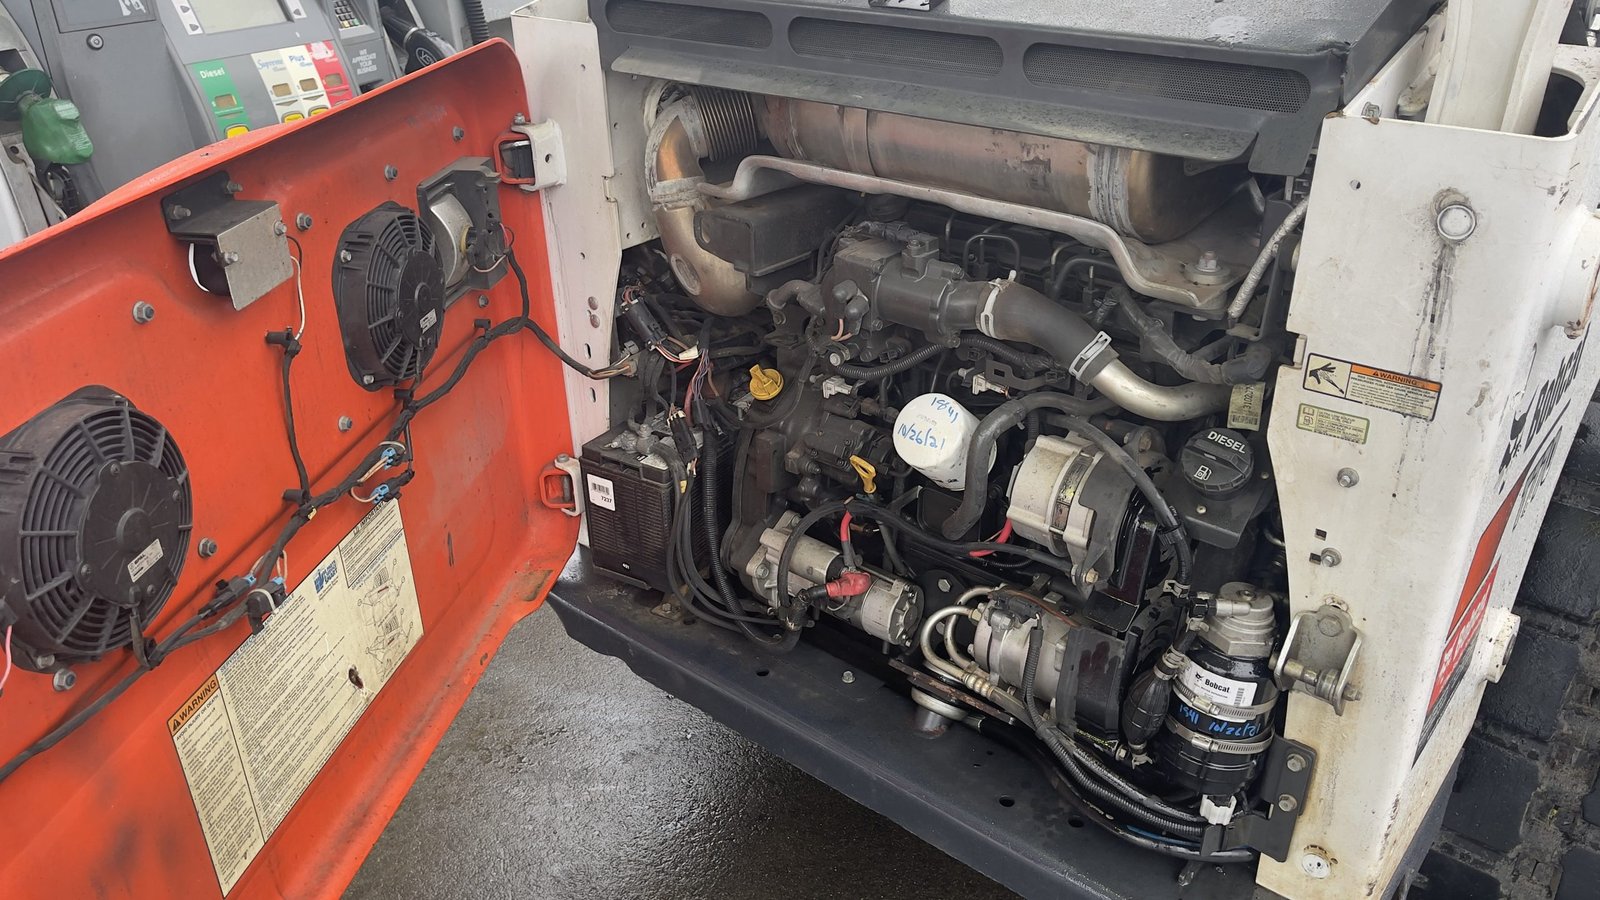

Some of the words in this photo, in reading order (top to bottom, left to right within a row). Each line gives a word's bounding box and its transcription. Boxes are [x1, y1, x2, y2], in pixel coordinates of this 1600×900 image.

[352, 53, 376, 63] APPRECIATE
[200, 67, 225, 79] Diesel
[357, 65, 377, 74] BUSINESS
[1380, 372, 1417, 385] WARNING
[931, 397, 959, 424] 1841
[897, 423, 946, 451] 10/26/21
[1207, 430, 1246, 454] DIESEL
[1204, 678, 1230, 693] Bobcat
[179, 679, 217, 721] WARNING
